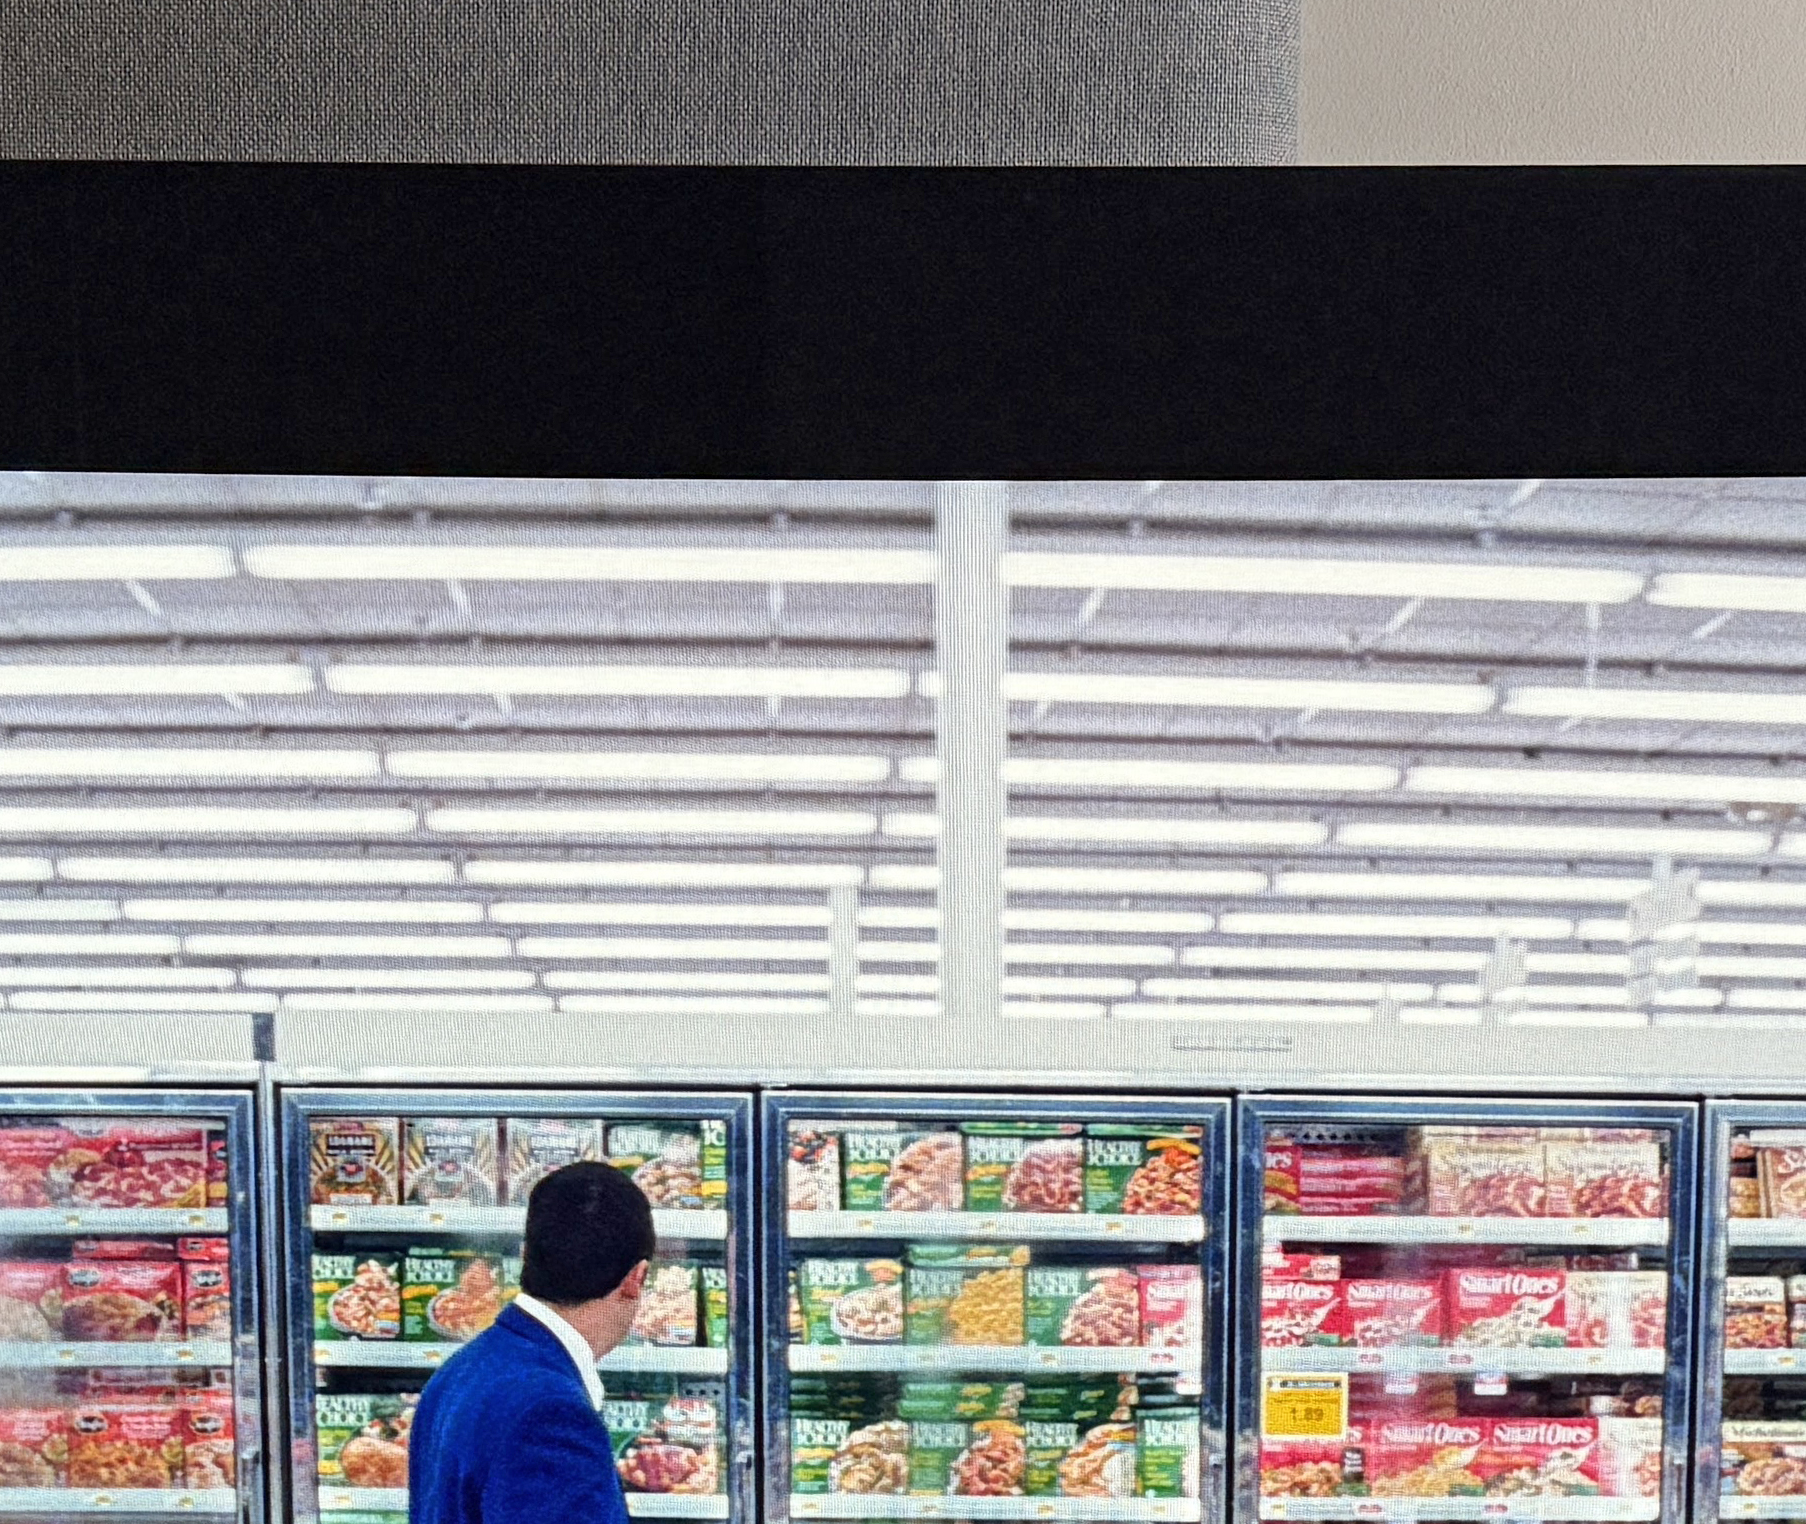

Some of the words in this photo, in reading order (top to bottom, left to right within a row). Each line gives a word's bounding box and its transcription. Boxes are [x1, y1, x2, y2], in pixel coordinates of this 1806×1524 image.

[1460, 1274, 1512, 1294] Smart
[1512, 1275, 1560, 1295] Ones
[1434, 1423, 1480, 1443] Ones
[1494, 1423, 1547, 1442] Smart
[1547, 1423, 1592, 1443] Ones
